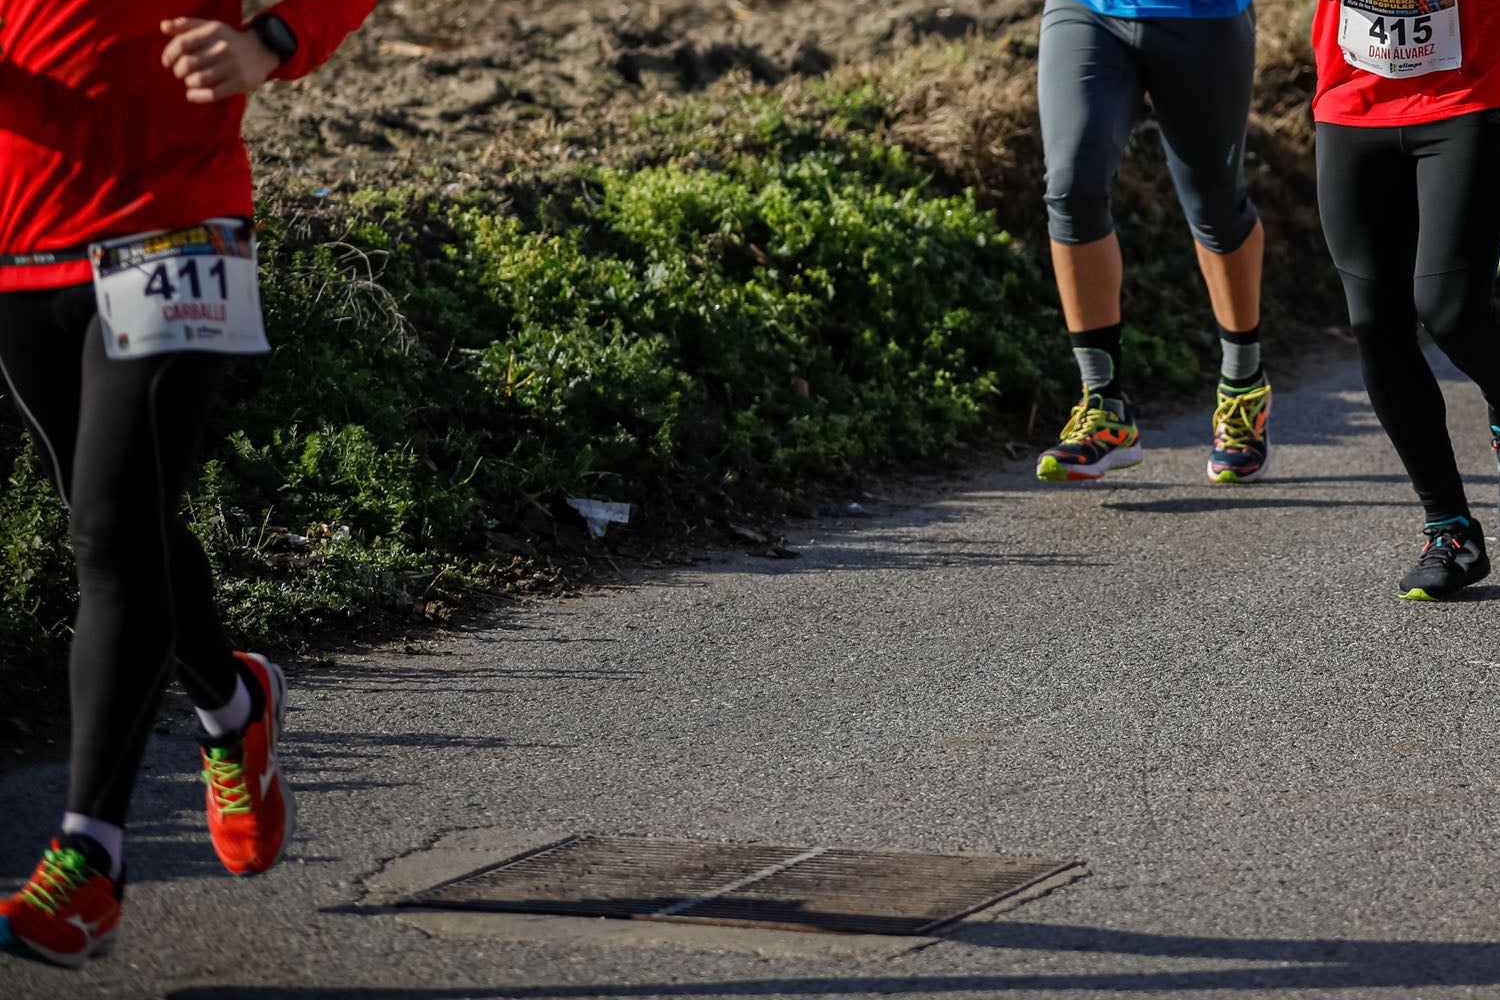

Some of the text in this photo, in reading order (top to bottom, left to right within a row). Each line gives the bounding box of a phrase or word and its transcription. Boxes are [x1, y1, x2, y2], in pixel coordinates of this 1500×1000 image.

[1372, 0, 1415, 10] POPULAR
[1369, 15, 1433, 46] 415
[1368, 43, 1436, 60] DANI ÁLVAREZ
[144, 257, 228, 301] 411
